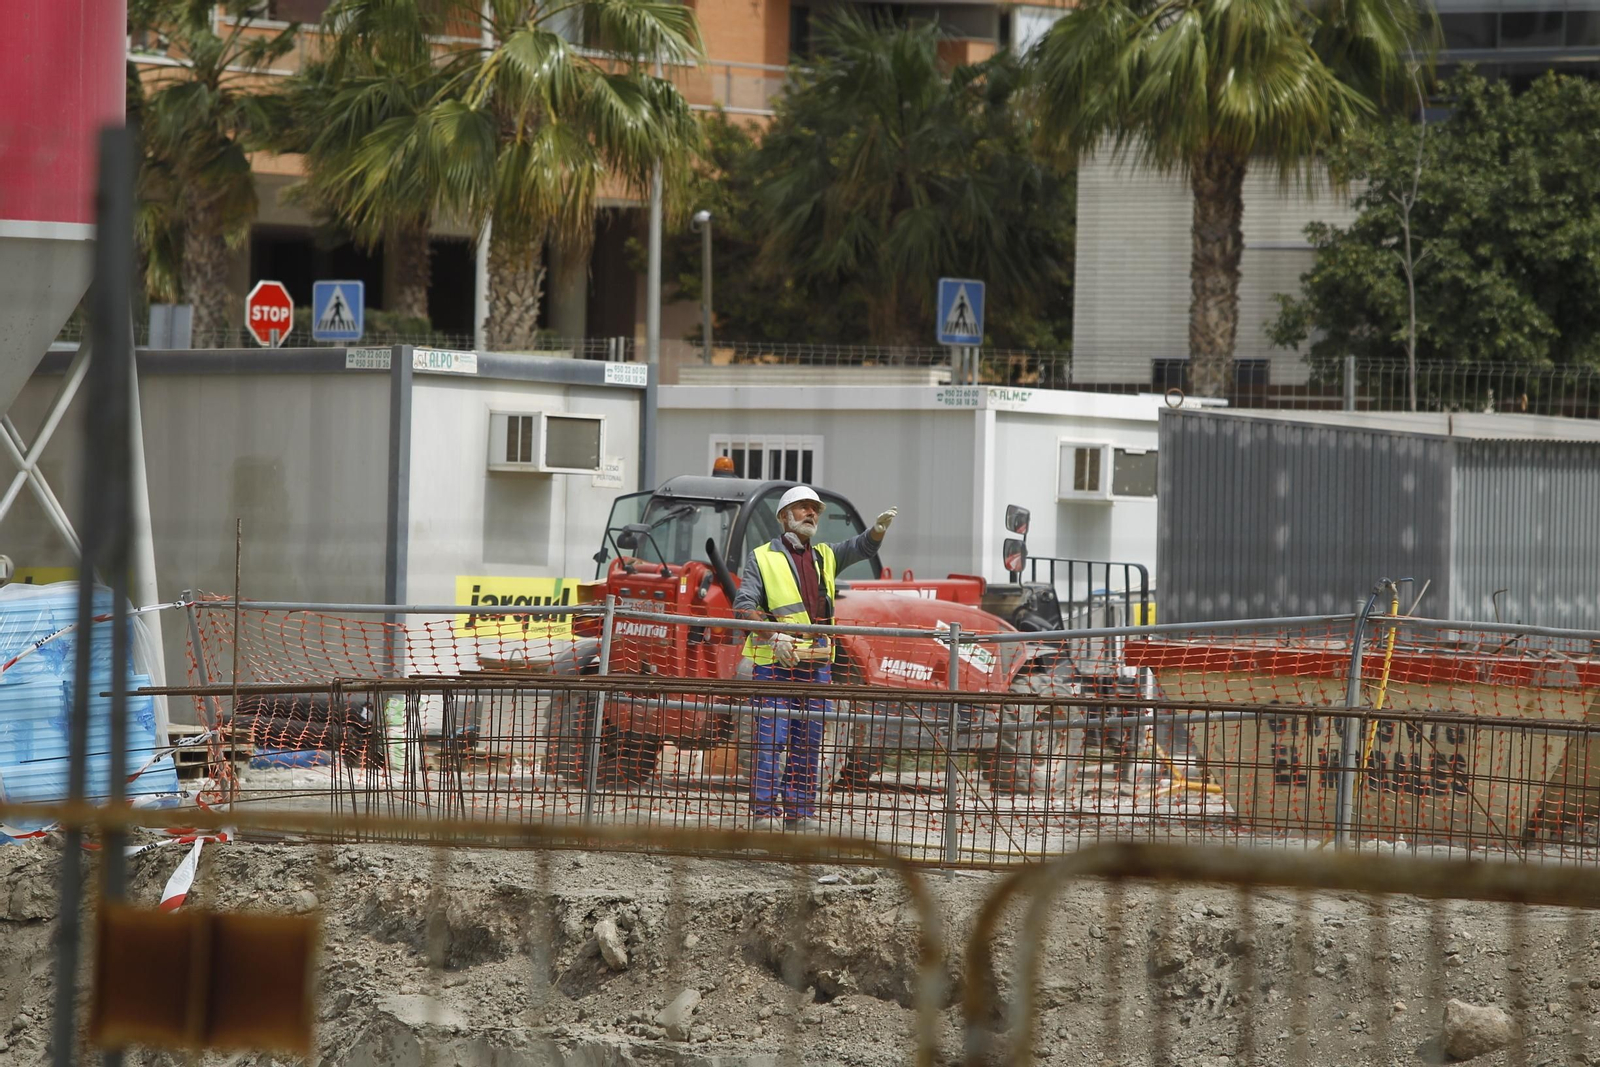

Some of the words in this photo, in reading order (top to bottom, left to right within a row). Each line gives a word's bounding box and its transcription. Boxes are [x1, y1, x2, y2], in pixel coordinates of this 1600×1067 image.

[251, 305, 289, 322] STOP
[355, 350, 366, 359] 950
[367, 350, 374, 359] 22
[383, 349, 390, 359] 00
[355, 360, 366, 368] 950
[615, 621, 668, 638] MANITOU
[880, 656, 934, 681] MANITOU
